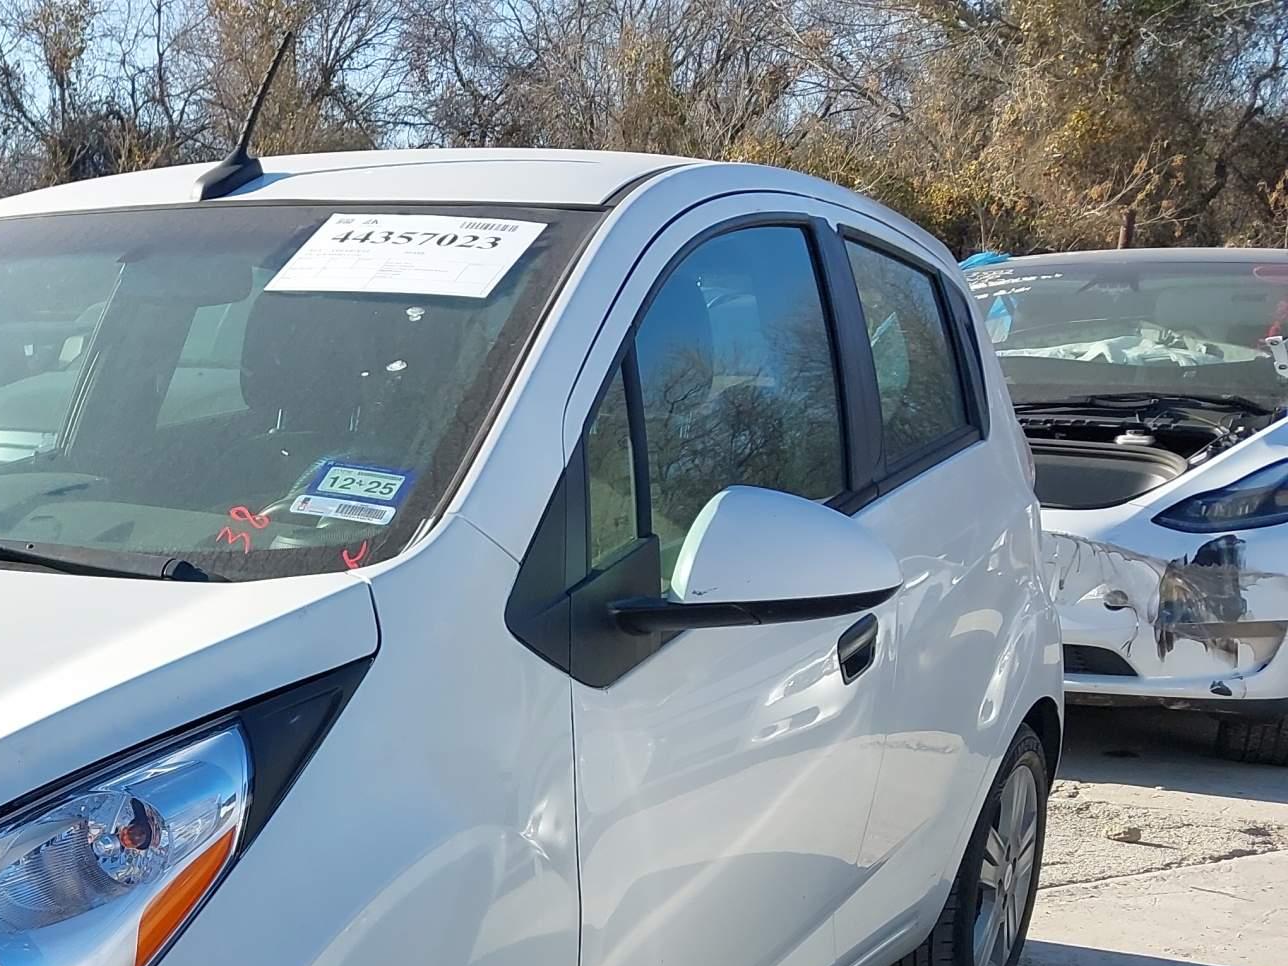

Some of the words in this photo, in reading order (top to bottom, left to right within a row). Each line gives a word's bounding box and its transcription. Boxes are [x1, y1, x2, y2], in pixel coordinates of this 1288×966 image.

[331, 230, 502, 249] 44357023
[330, 475, 356, 490] 12
[364, 480, 397, 496] 25
